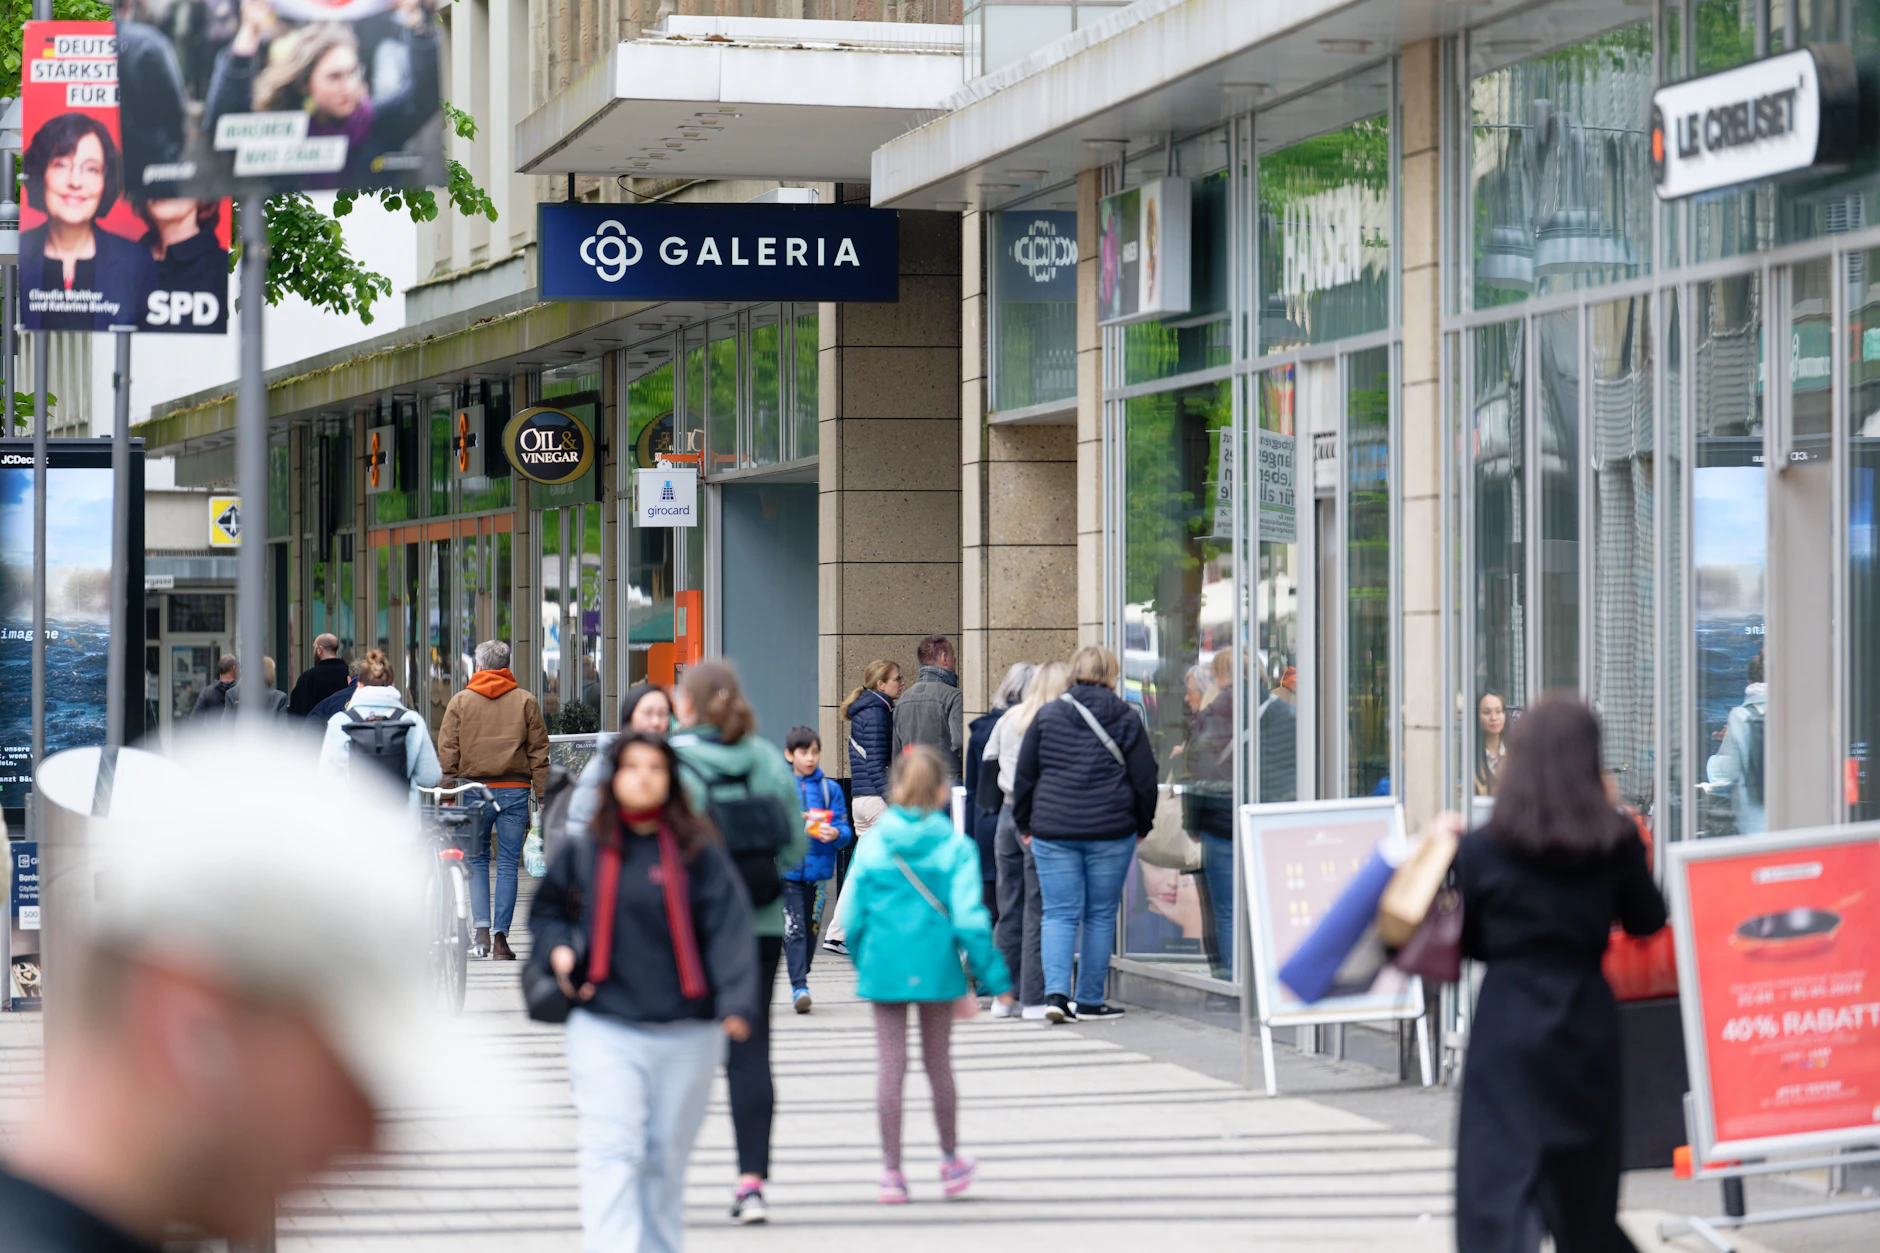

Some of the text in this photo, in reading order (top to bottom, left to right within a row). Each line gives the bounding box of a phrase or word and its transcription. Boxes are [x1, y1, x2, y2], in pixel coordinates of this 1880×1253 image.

[35, 59, 118, 78] STÄRKST
[71, 83, 106, 102] FÜR
[1677, 85, 1797, 158] LE CREUSET
[658, 236, 860, 266] GALERIA
[28, 301, 49, 312] und
[49, 301, 88, 313] Katarina
[146, 289, 220, 326] SPD
[521, 451, 580, 464] VINEGAR
[647, 505, 690, 518] girocard
[1721, 1001, 1880, 1043] 40% RABATT
